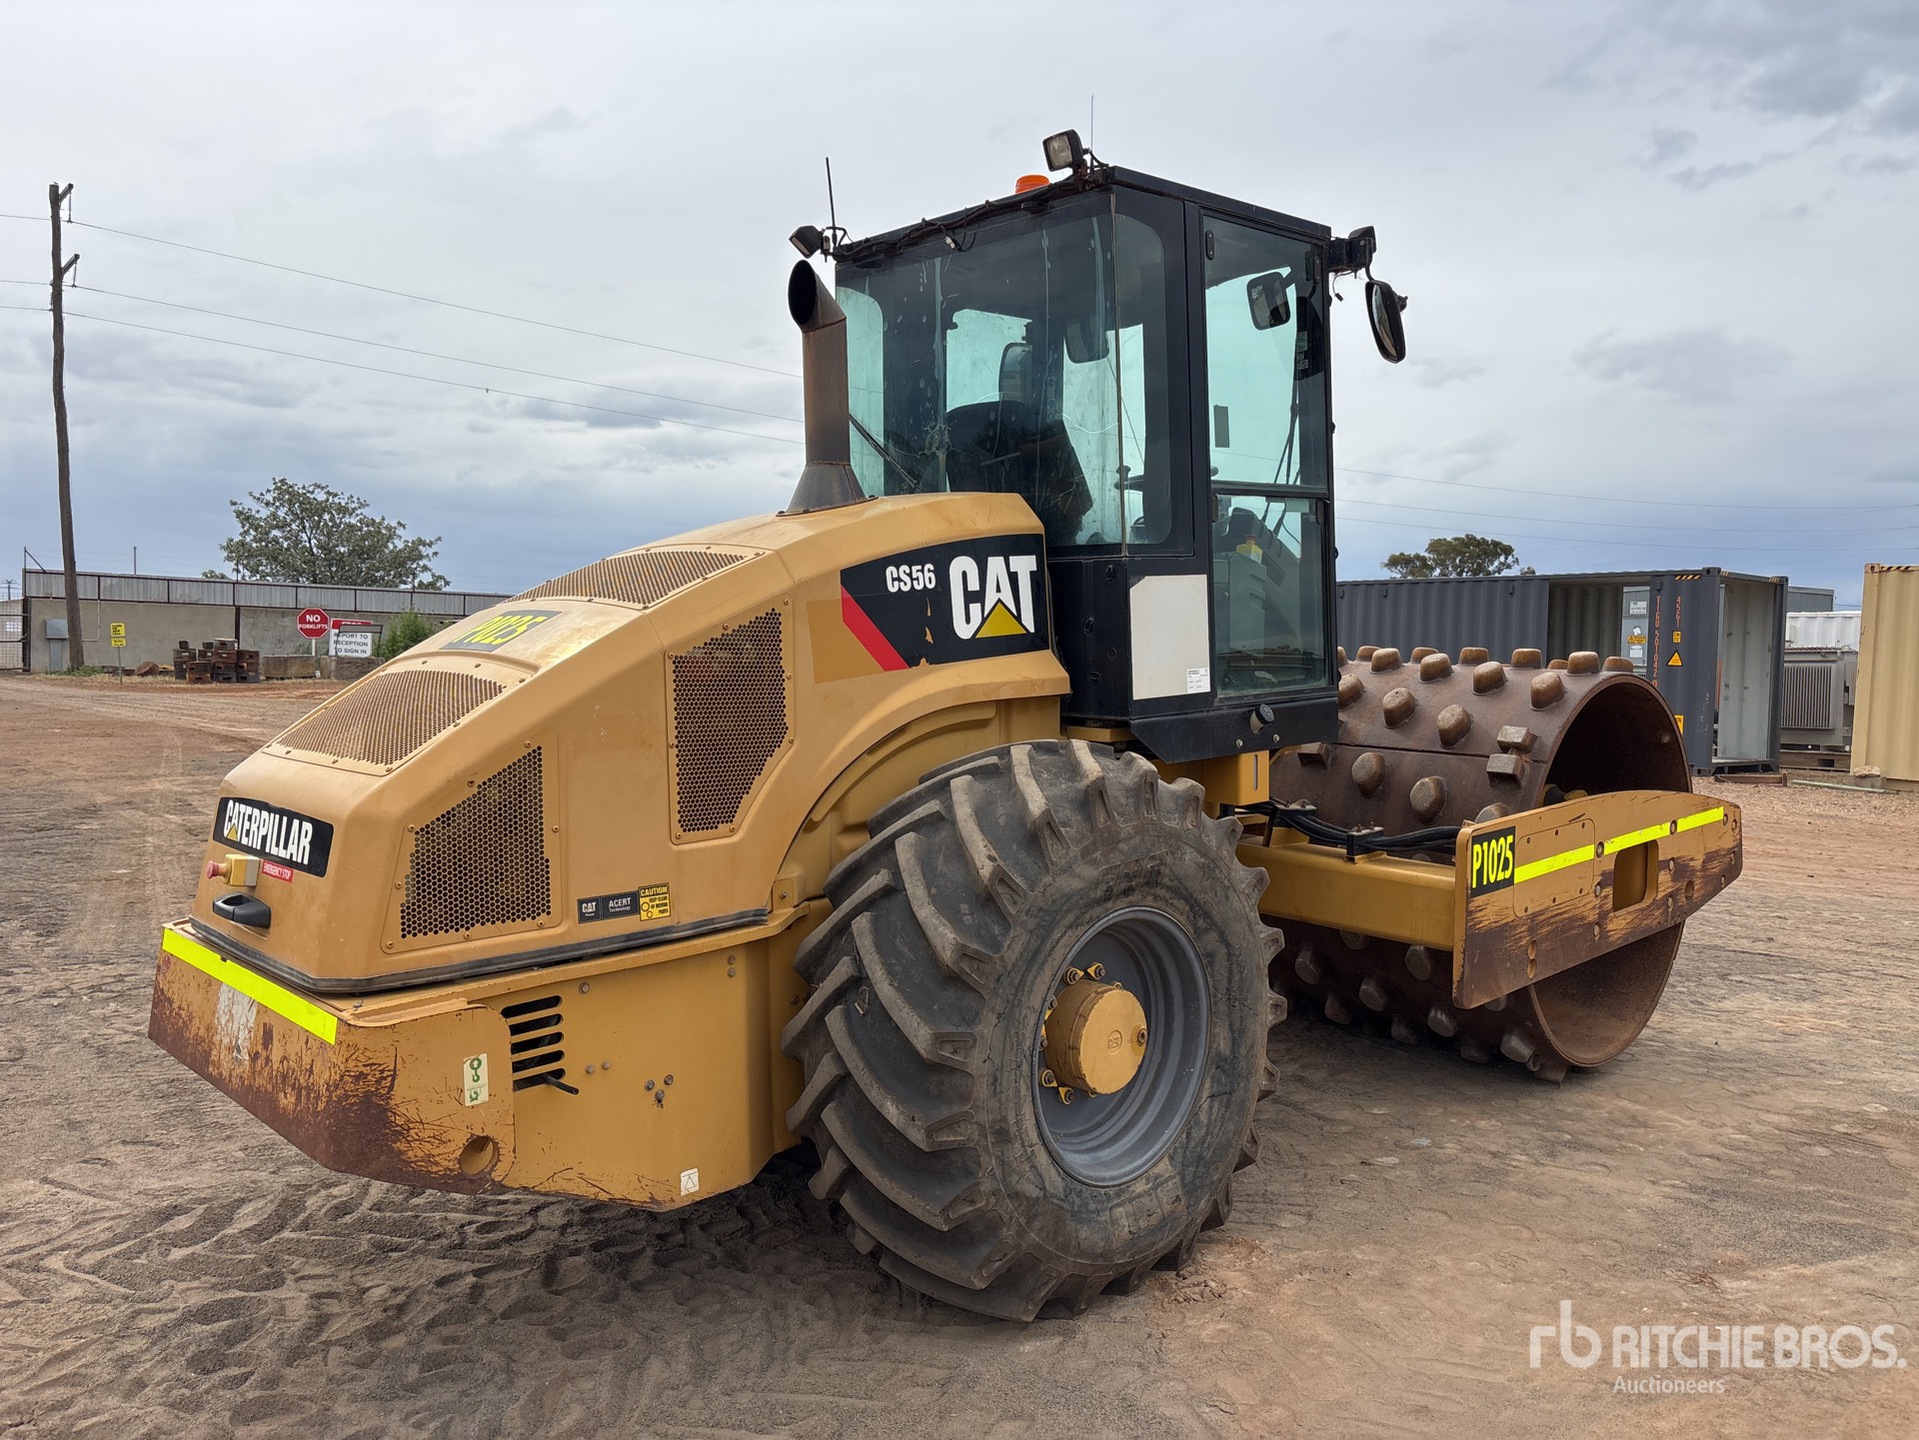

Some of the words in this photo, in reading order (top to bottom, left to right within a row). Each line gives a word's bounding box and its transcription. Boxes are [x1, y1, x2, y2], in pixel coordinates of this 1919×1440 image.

[885, 563, 936, 593] CS56
[949, 555, 1038, 640] CAT
[306, 614, 321, 623] NO
[452, 614, 549, 645] P1025
[223, 799, 313, 865] CATERPILLAR
[1472, 834, 1514, 889] P1025
[608, 897, 632, 908] ACERT
[640, 886, 668, 896] CAUTION
[582, 902, 597, 913] CAT
